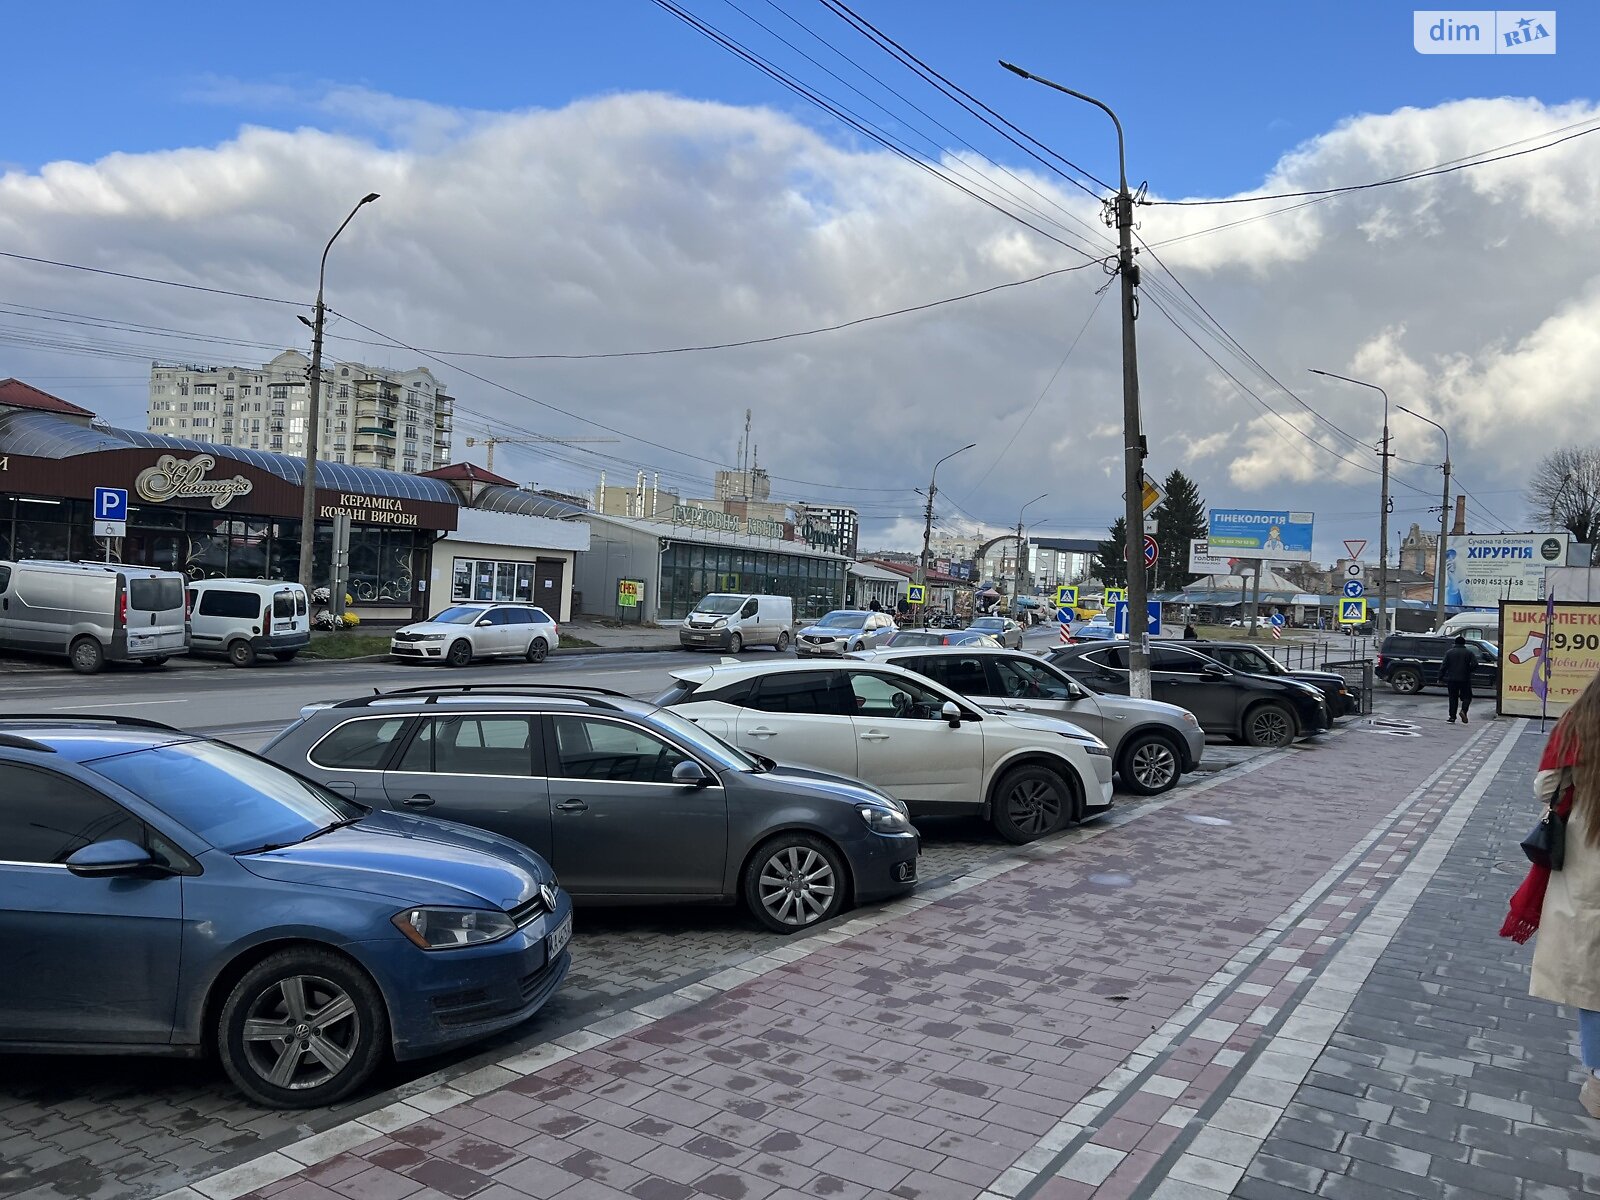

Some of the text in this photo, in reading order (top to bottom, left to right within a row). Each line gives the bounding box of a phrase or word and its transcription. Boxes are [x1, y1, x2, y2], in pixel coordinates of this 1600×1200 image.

[136, 455, 252, 509] Фантазія
[102, 491, 120, 516] P
[340, 493, 402, 511] КЕРАМІКА
[320, 505, 418, 526] КОВАНІ ВИРОБИ
[672, 504, 740, 532] ГУРТОВНЯ
[747, 517, 784, 539] КВІТІВ
[1214, 513, 1287, 525] ГІНЕКОЛОГІЯ
[1468, 538, 1493, 546] Сучасна
[1503, 537, 1534, 545] безпечна
[1467, 546, 1533, 559] ХІРУРГІЯ
[1549, 633, 1600, 652] 9,90
[1508, 685, 1552, 694] МАГАН
